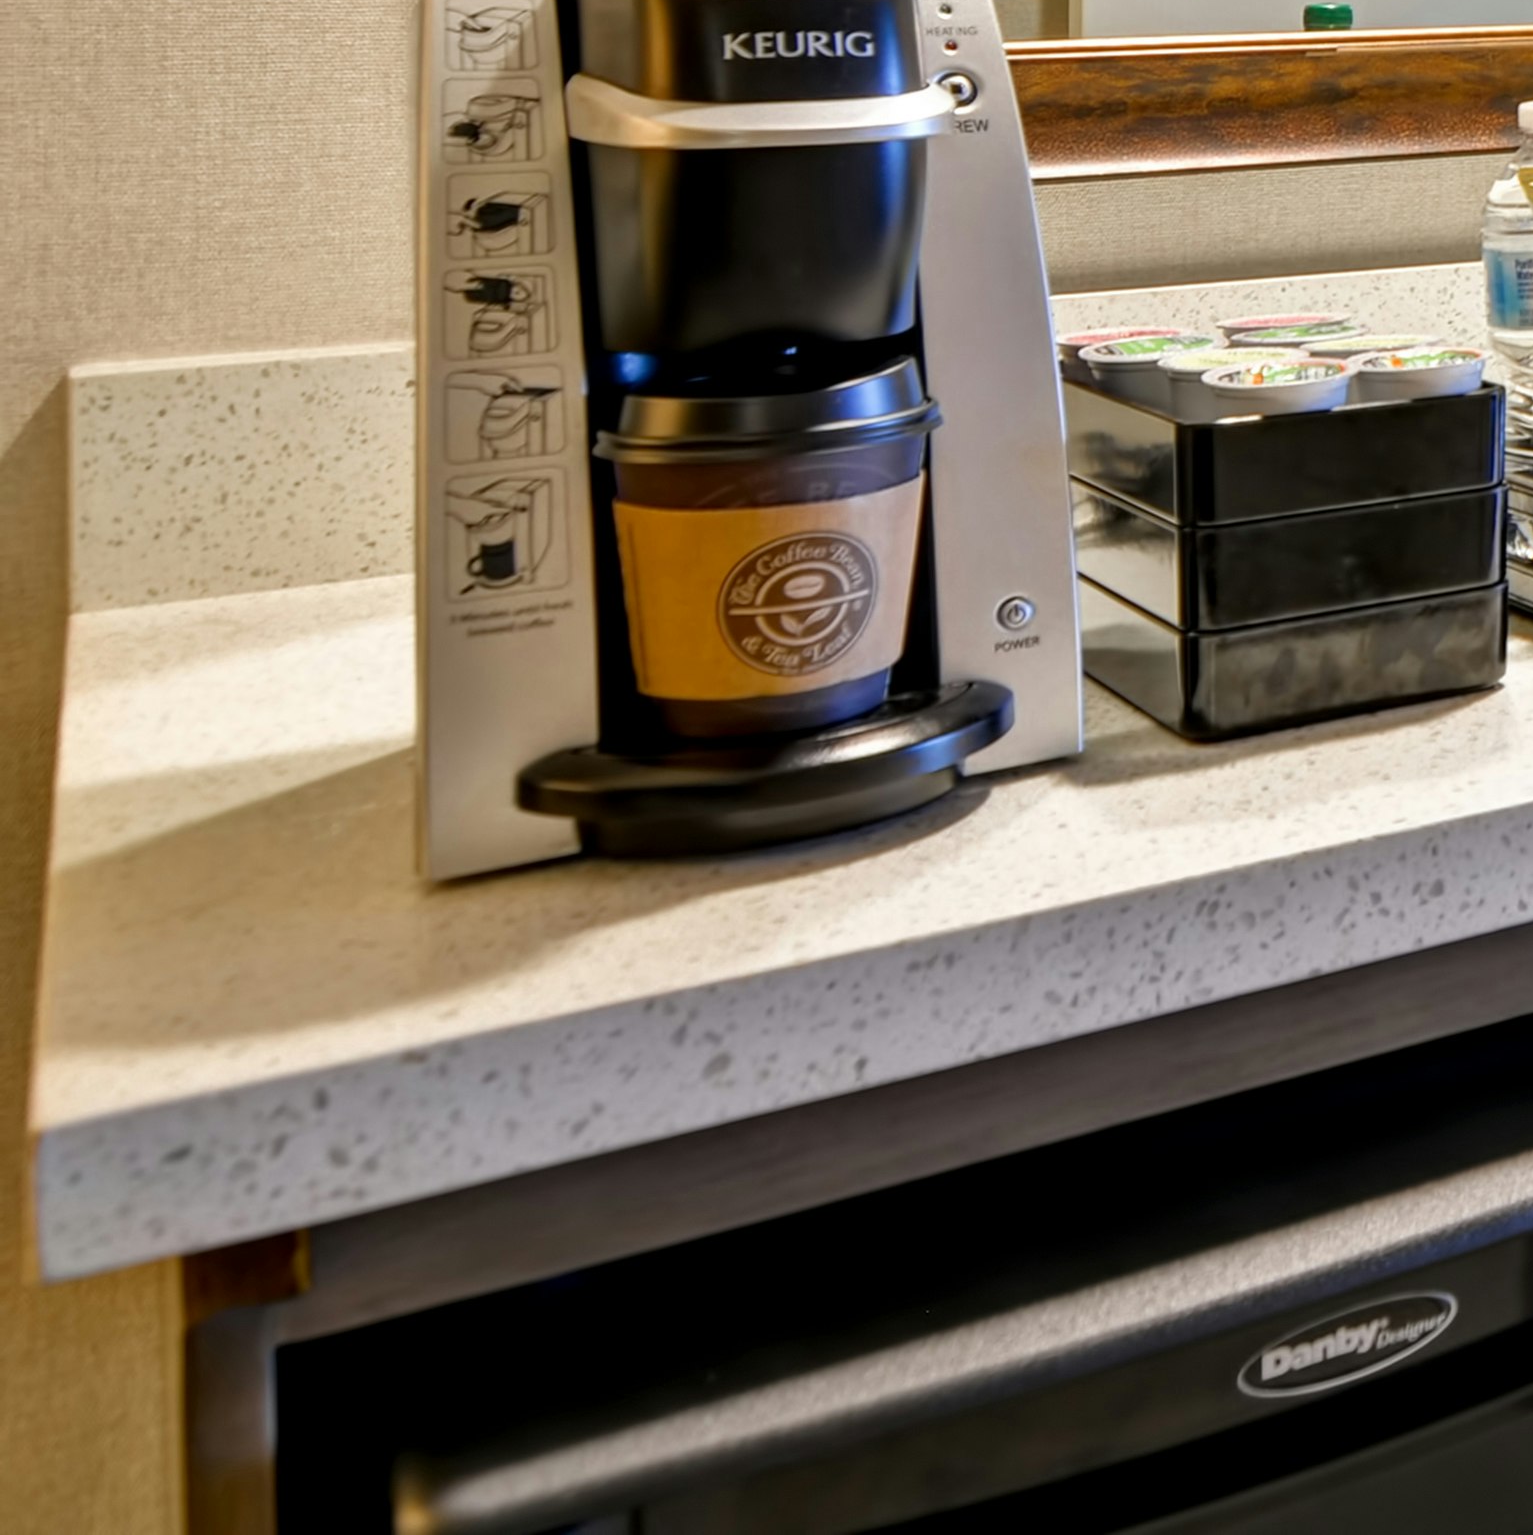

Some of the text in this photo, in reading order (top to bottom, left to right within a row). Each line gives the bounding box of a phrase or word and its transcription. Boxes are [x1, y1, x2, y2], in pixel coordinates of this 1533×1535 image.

[925, 26, 979, 36] HEATING
[723, 31, 876, 60] KEURIG
[756, 542, 827, 576] Coffee
[830, 543, 864, 588] Bean
[762, 644, 800, 667] Tea
[994, 636, 1040, 653] POWER
[1261, 1318, 1379, 1381] Danby
